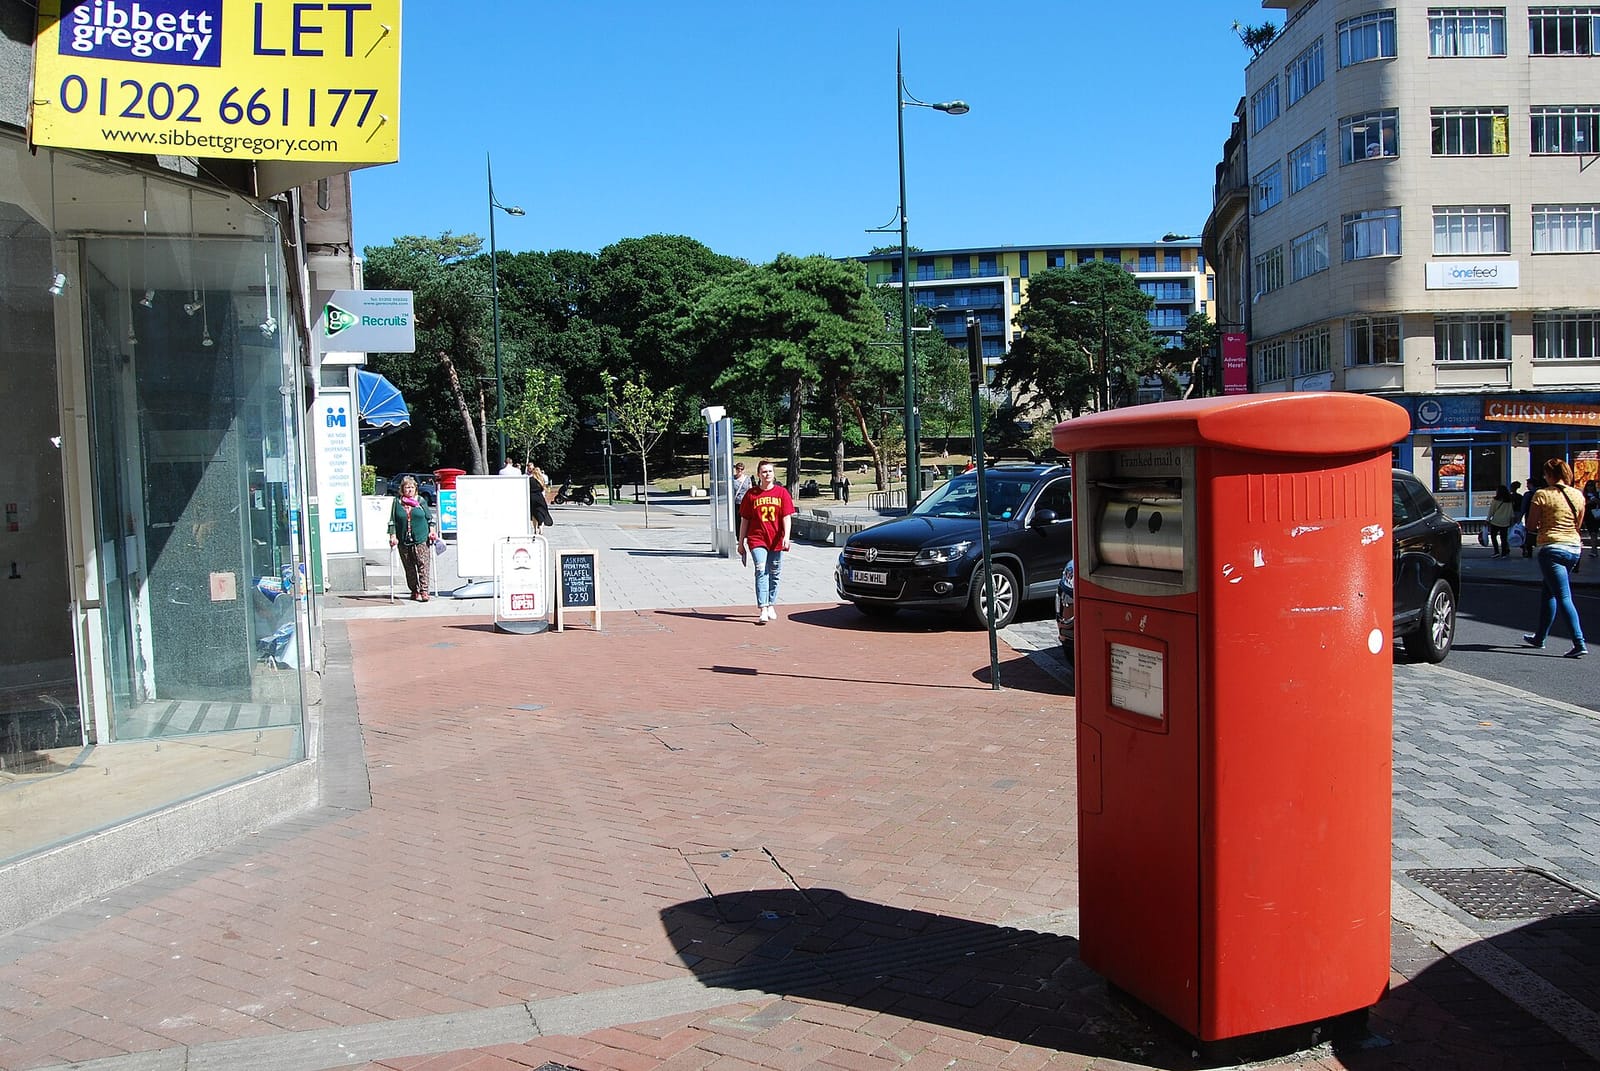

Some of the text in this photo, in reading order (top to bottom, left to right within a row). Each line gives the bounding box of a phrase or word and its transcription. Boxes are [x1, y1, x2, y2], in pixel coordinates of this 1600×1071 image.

[73, 0, 213, 34] sibbett
[253, 2, 372, 57] LET
[71, 25, 213, 61] gregory
[60, 74, 379, 128] 01202 661177
[101, 127, 338, 155] www.sibbettgregory.com
[1452, 265, 1498, 278] onefeed
[362, 315, 407, 326] Recruits
[1489, 403, 1600, 419] CHKN STATIO
[1120, 452, 1152, 467] Franked
[1154, 452, 1173, 466] mail
[761, 506, 776, 522] 23
[330, 522, 353, 532] NHS
[512, 600, 533, 609] OPEN
